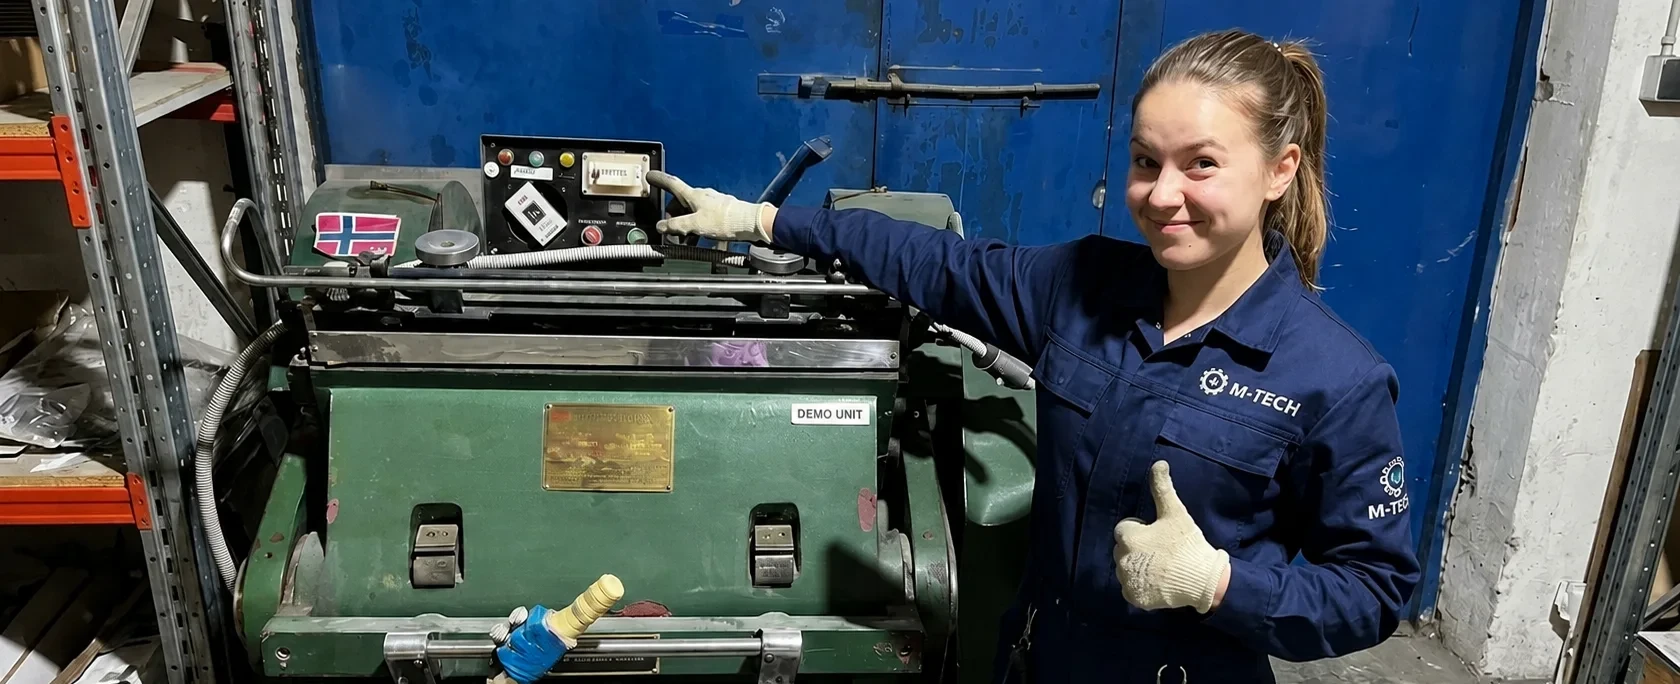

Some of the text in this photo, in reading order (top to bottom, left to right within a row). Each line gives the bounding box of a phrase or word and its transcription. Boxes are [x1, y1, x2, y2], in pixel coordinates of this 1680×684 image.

[1229, 382, 1301, 417] M-TECH
[797, 408, 863, 420] DEMO UNIT
[1368, 494, 1409, 519] M-TEC
